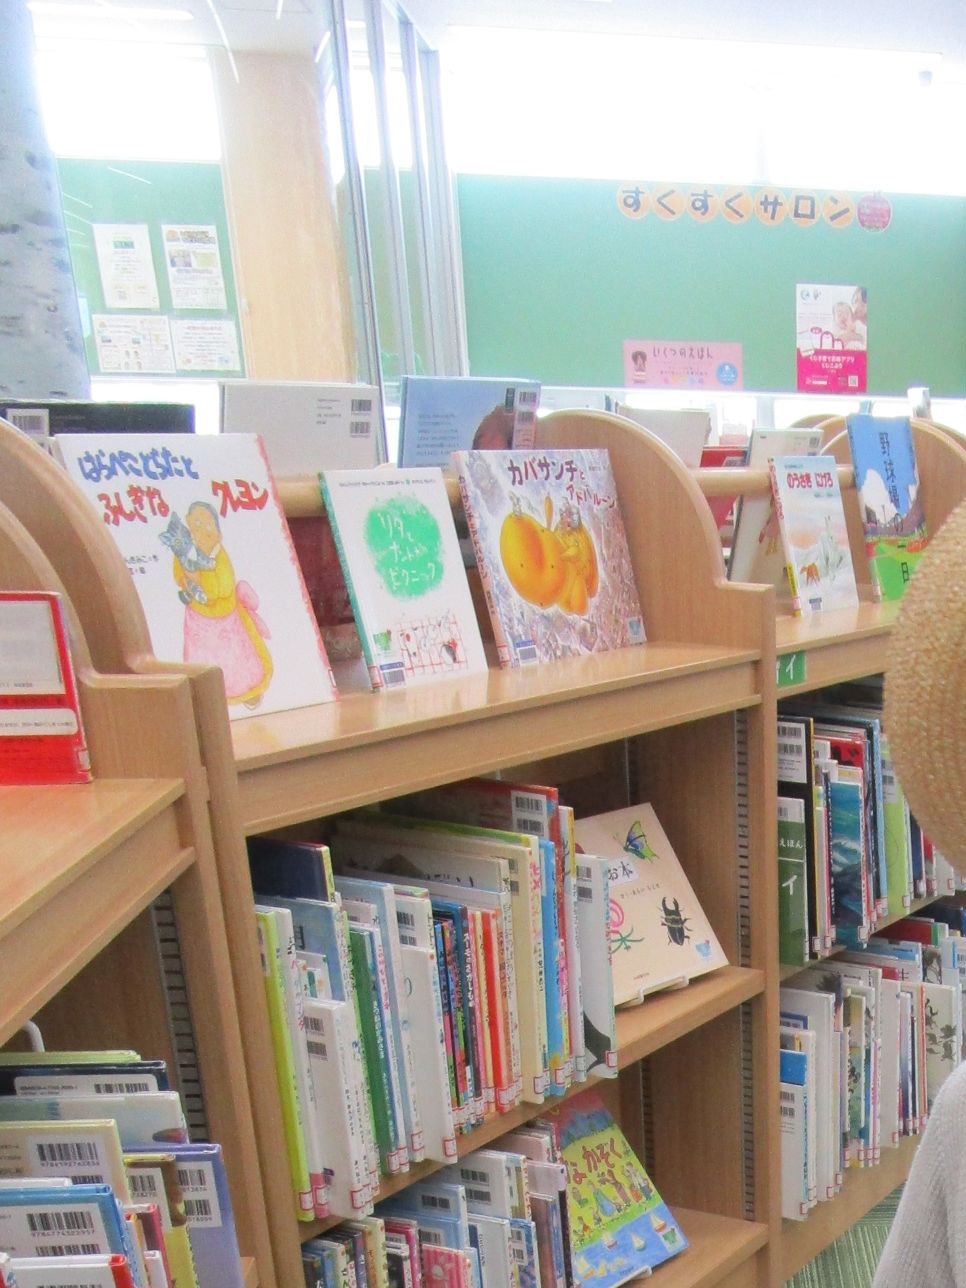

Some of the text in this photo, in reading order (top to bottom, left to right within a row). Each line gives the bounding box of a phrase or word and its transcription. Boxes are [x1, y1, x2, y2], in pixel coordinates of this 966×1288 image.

[621, 186, 851, 221] すくすくサロン
[779, 838, 804, 849] えほん
[582, 1137, 622, 1173] かぞく
